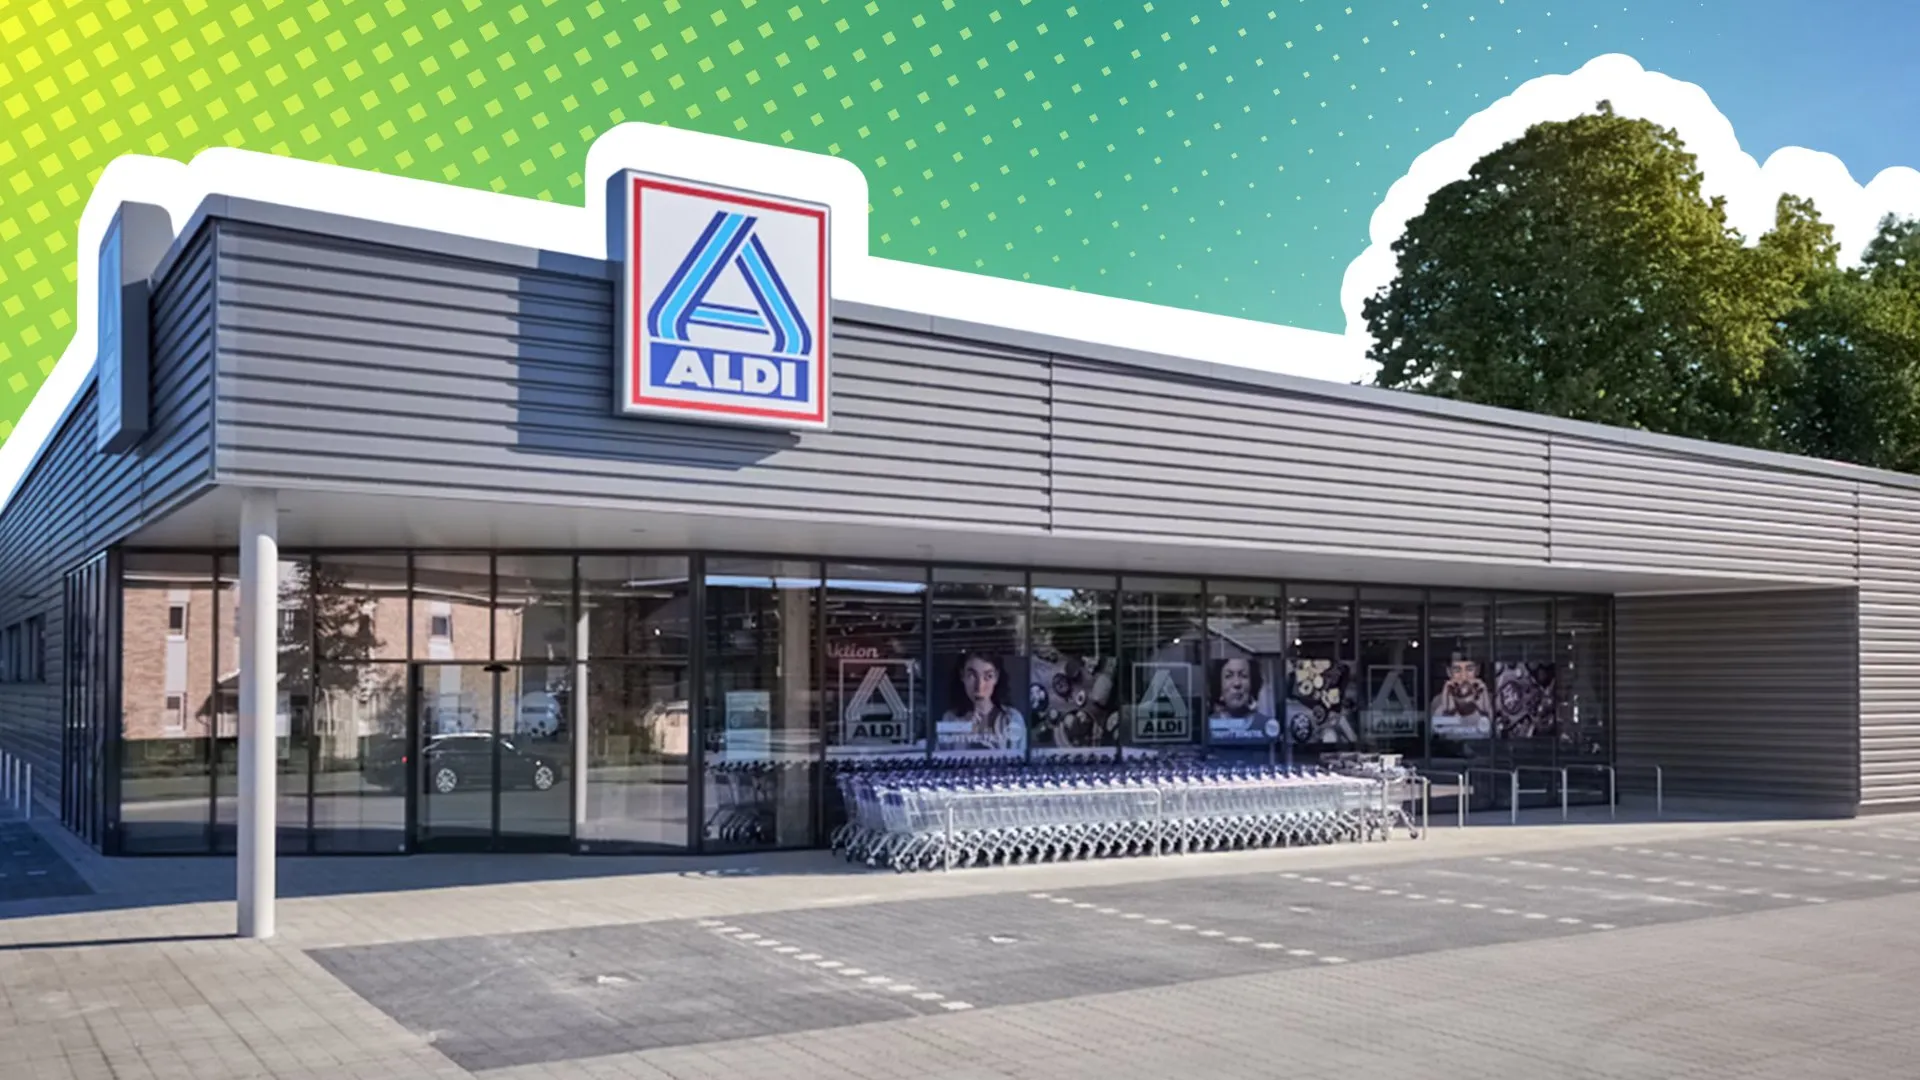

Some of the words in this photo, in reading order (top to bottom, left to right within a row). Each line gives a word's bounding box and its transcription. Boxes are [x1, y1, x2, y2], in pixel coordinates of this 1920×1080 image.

[664, 349, 797, 398] ALDI
[853, 724, 902, 738] ALDI
[1143, 717, 1183, 733] ALDI
